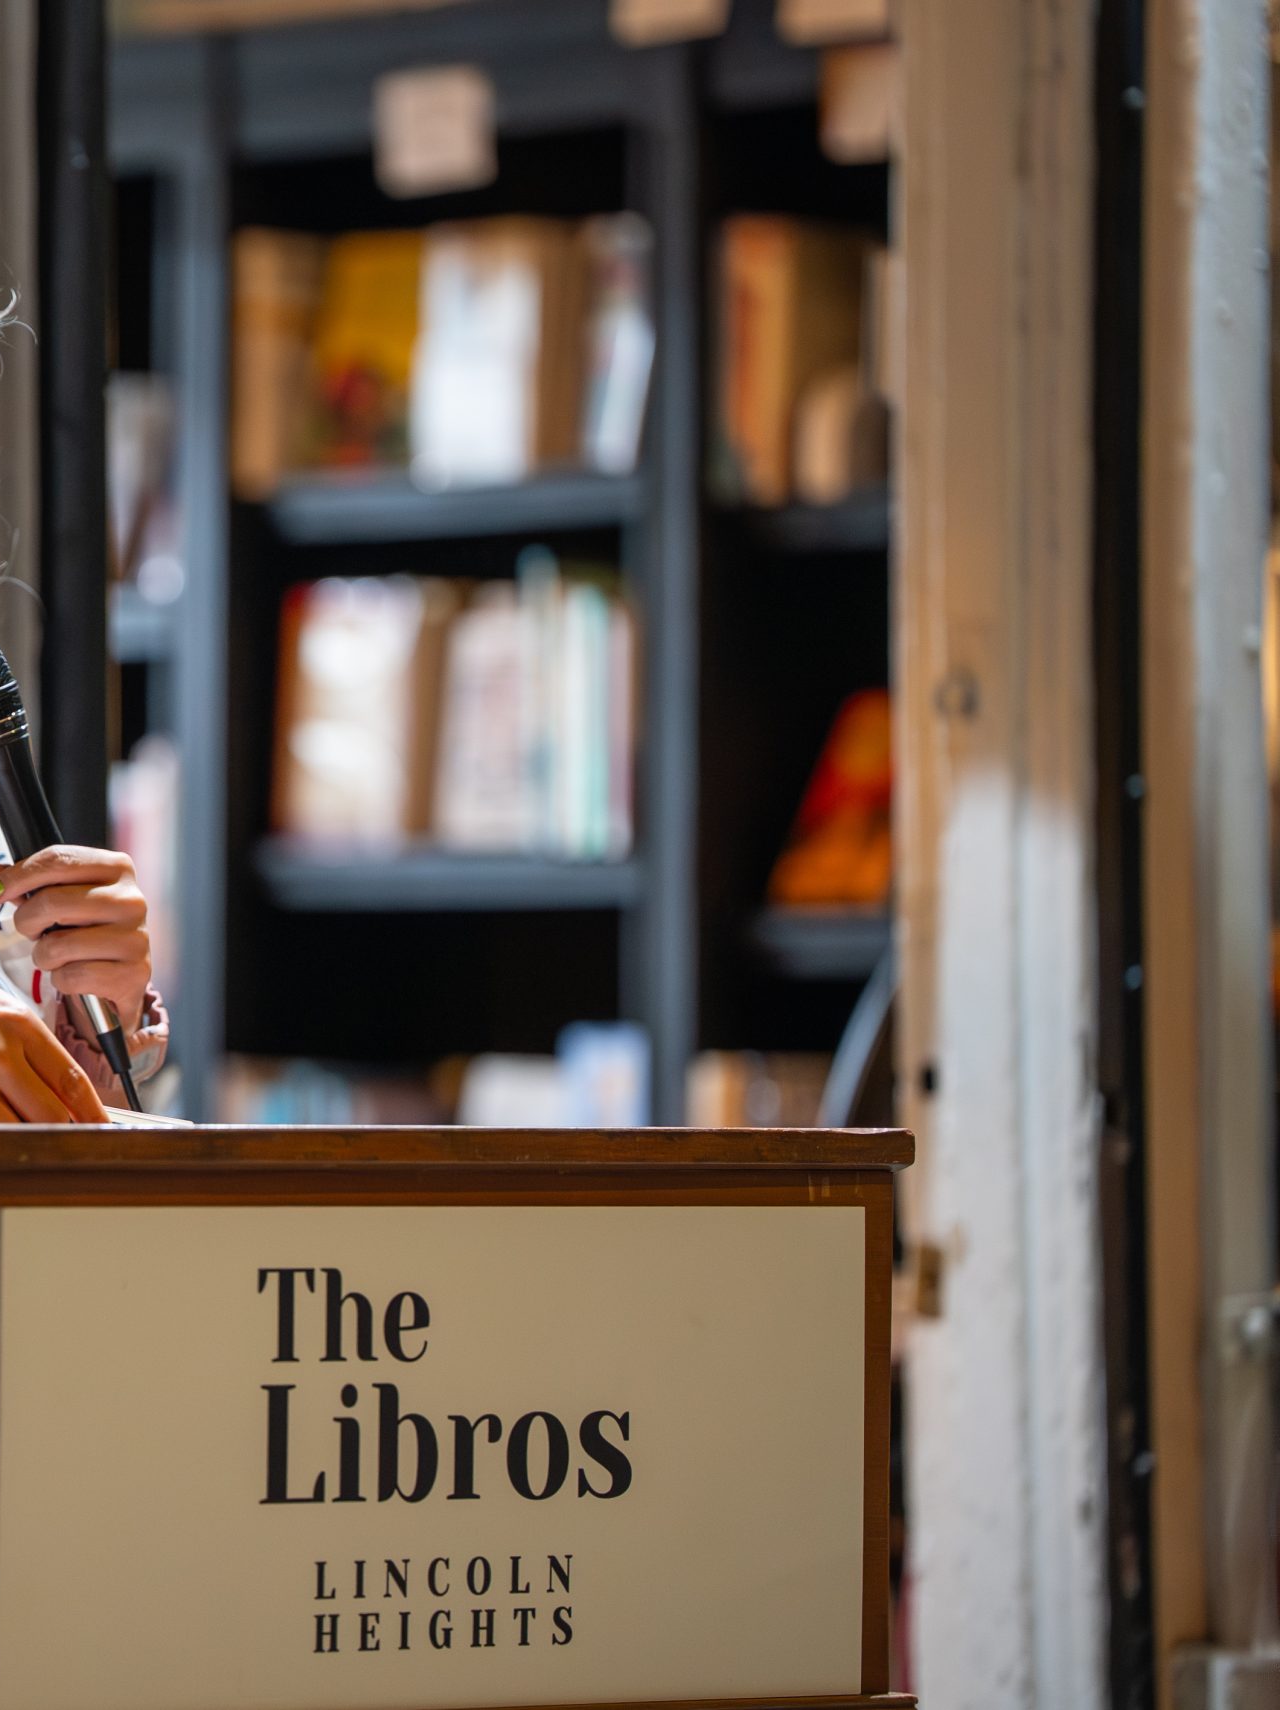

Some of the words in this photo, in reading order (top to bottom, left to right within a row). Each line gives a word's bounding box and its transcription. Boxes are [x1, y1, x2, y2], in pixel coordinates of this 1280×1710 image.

[257, 1266, 431, 1364] The
[258, 1382, 634, 1506] Libros
[313, 1553, 574, 1601] LINCOLN
[312, 1605, 574, 1655] HEIGHTS
